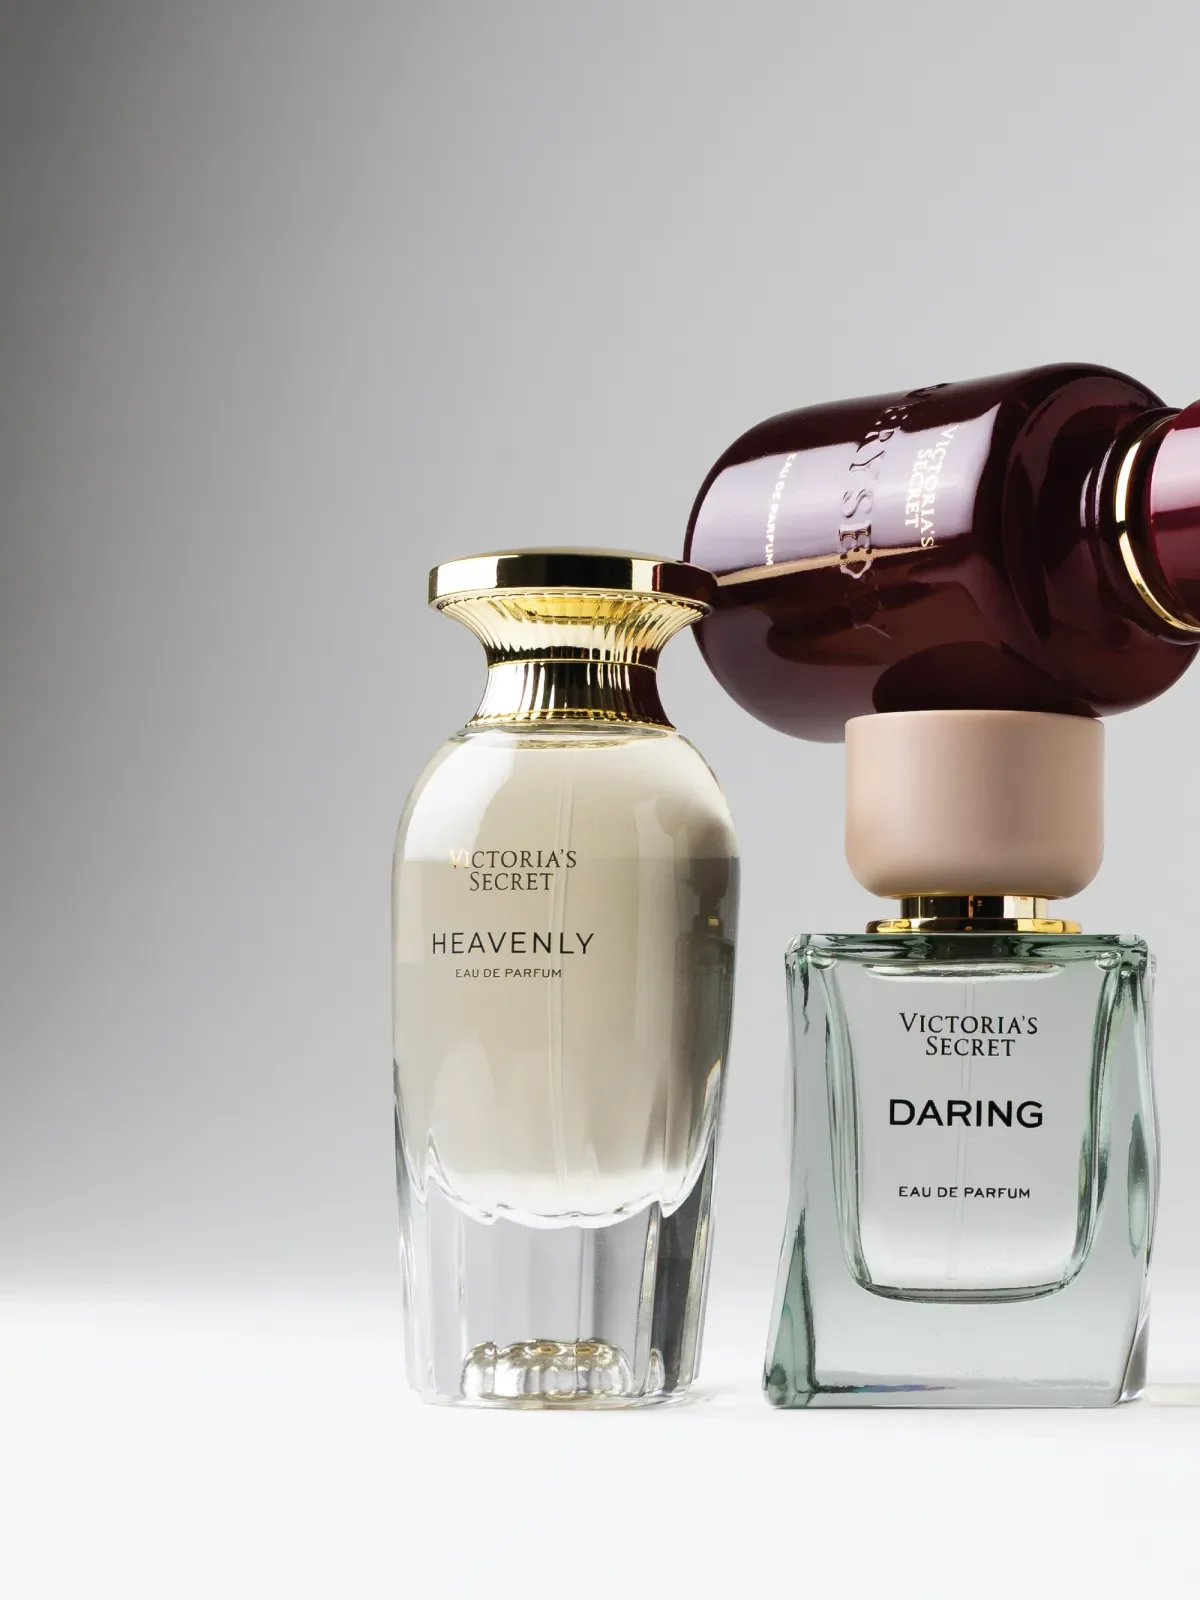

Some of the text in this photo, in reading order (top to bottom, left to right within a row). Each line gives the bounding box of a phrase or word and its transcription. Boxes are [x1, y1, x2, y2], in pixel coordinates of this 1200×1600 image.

[905, 448, 934, 529] SECRET
[920, 424, 959, 548] VICTORIA'S
[765, 452, 798, 566] EAU DE PARFUM
[450, 848, 577, 869] VICTORIA'S
[469, 871, 555, 892] SECRET
[432, 931, 595, 955] HEAVENLY
[455, 968, 562, 978] EAU DE PARFUM
[898, 1012, 1038, 1035] VICTORIA'S
[925, 1035, 1016, 1057] SECRET
[889, 1098, 1043, 1129] DARING
[898, 1186, 1030, 1199] EAU DE PARFUM
